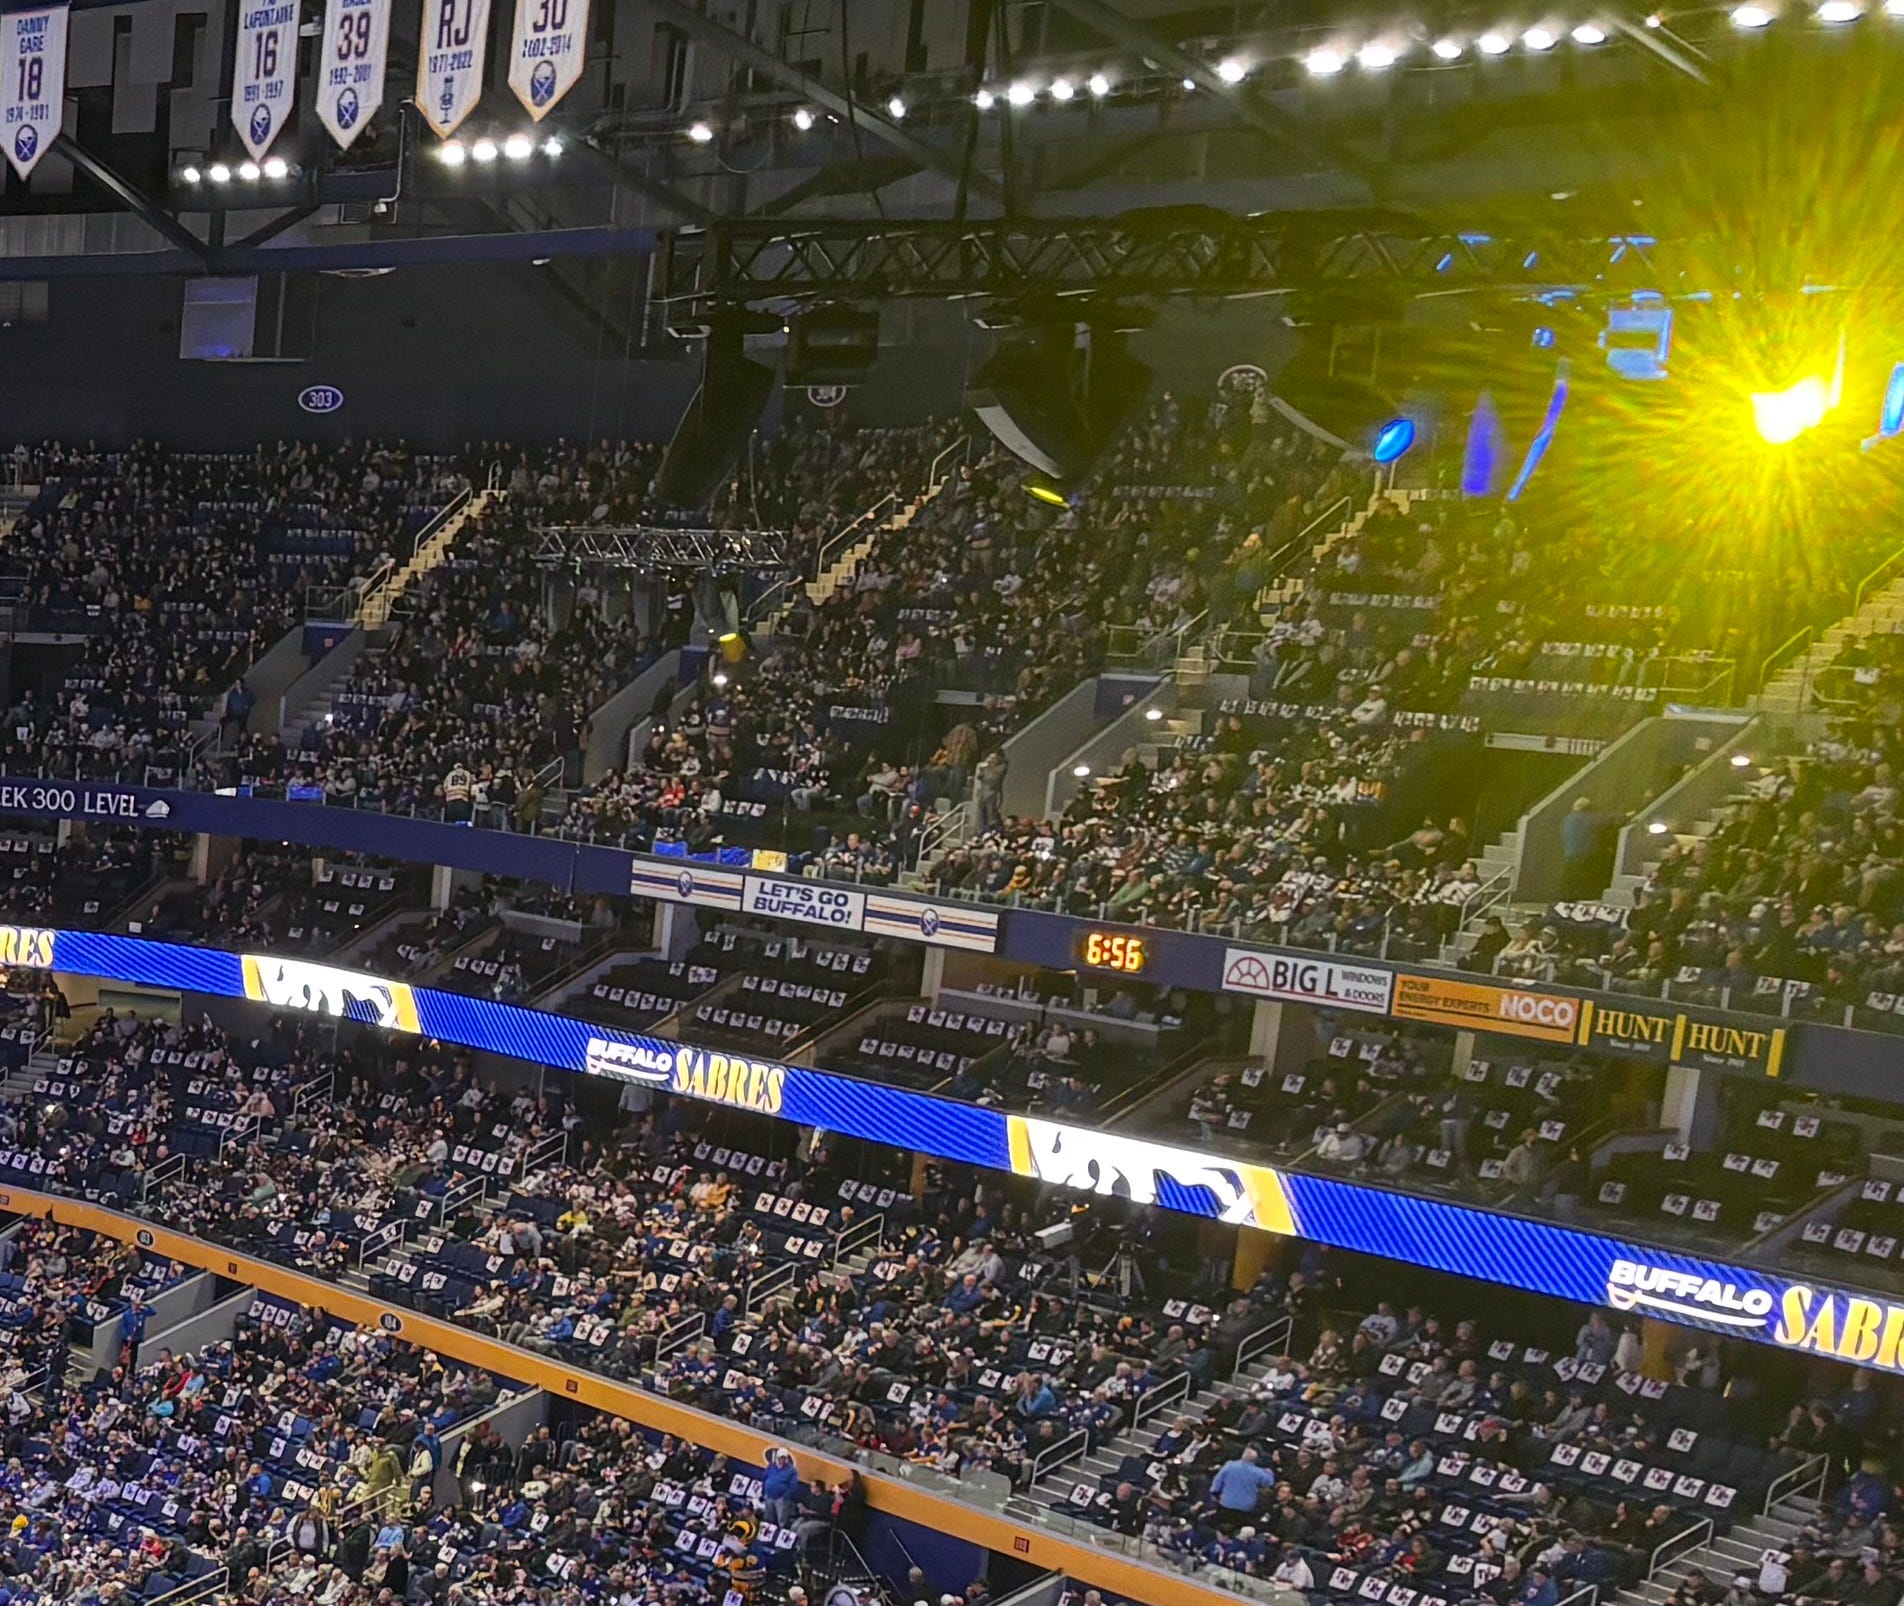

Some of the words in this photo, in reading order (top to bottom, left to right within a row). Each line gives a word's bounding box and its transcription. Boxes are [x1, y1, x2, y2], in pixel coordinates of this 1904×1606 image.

[337, 12, 370, 61] 39
[436, 0, 472, 49] RJ
[255, 31, 278, 80] 16
[19, 56, 43, 102] 18
[309, 391, 333, 408] 303
[32, 787, 76, 812] 300
[83, 791, 139, 818] LEVEL
[753, 896, 851, 924] BUFFALO!
[759, 881, 813, 902] LET'S
[818, 891, 849, 908] GO
[1087, 933, 1143, 971] 6:56
[1273, 960, 1317, 991] BIG
[1326, 967, 1338, 997] L
[1499, 993, 1574, 1027] NOCO
[1595, 1009, 1673, 1042] HUNT
[1687, 1023, 1770, 1058] HUNT
[586, 1037, 672, 1073] BUFFALO
[672, 1045, 786, 1115] SABRES
[1608, 1258, 1774, 1316] BUFFALO
